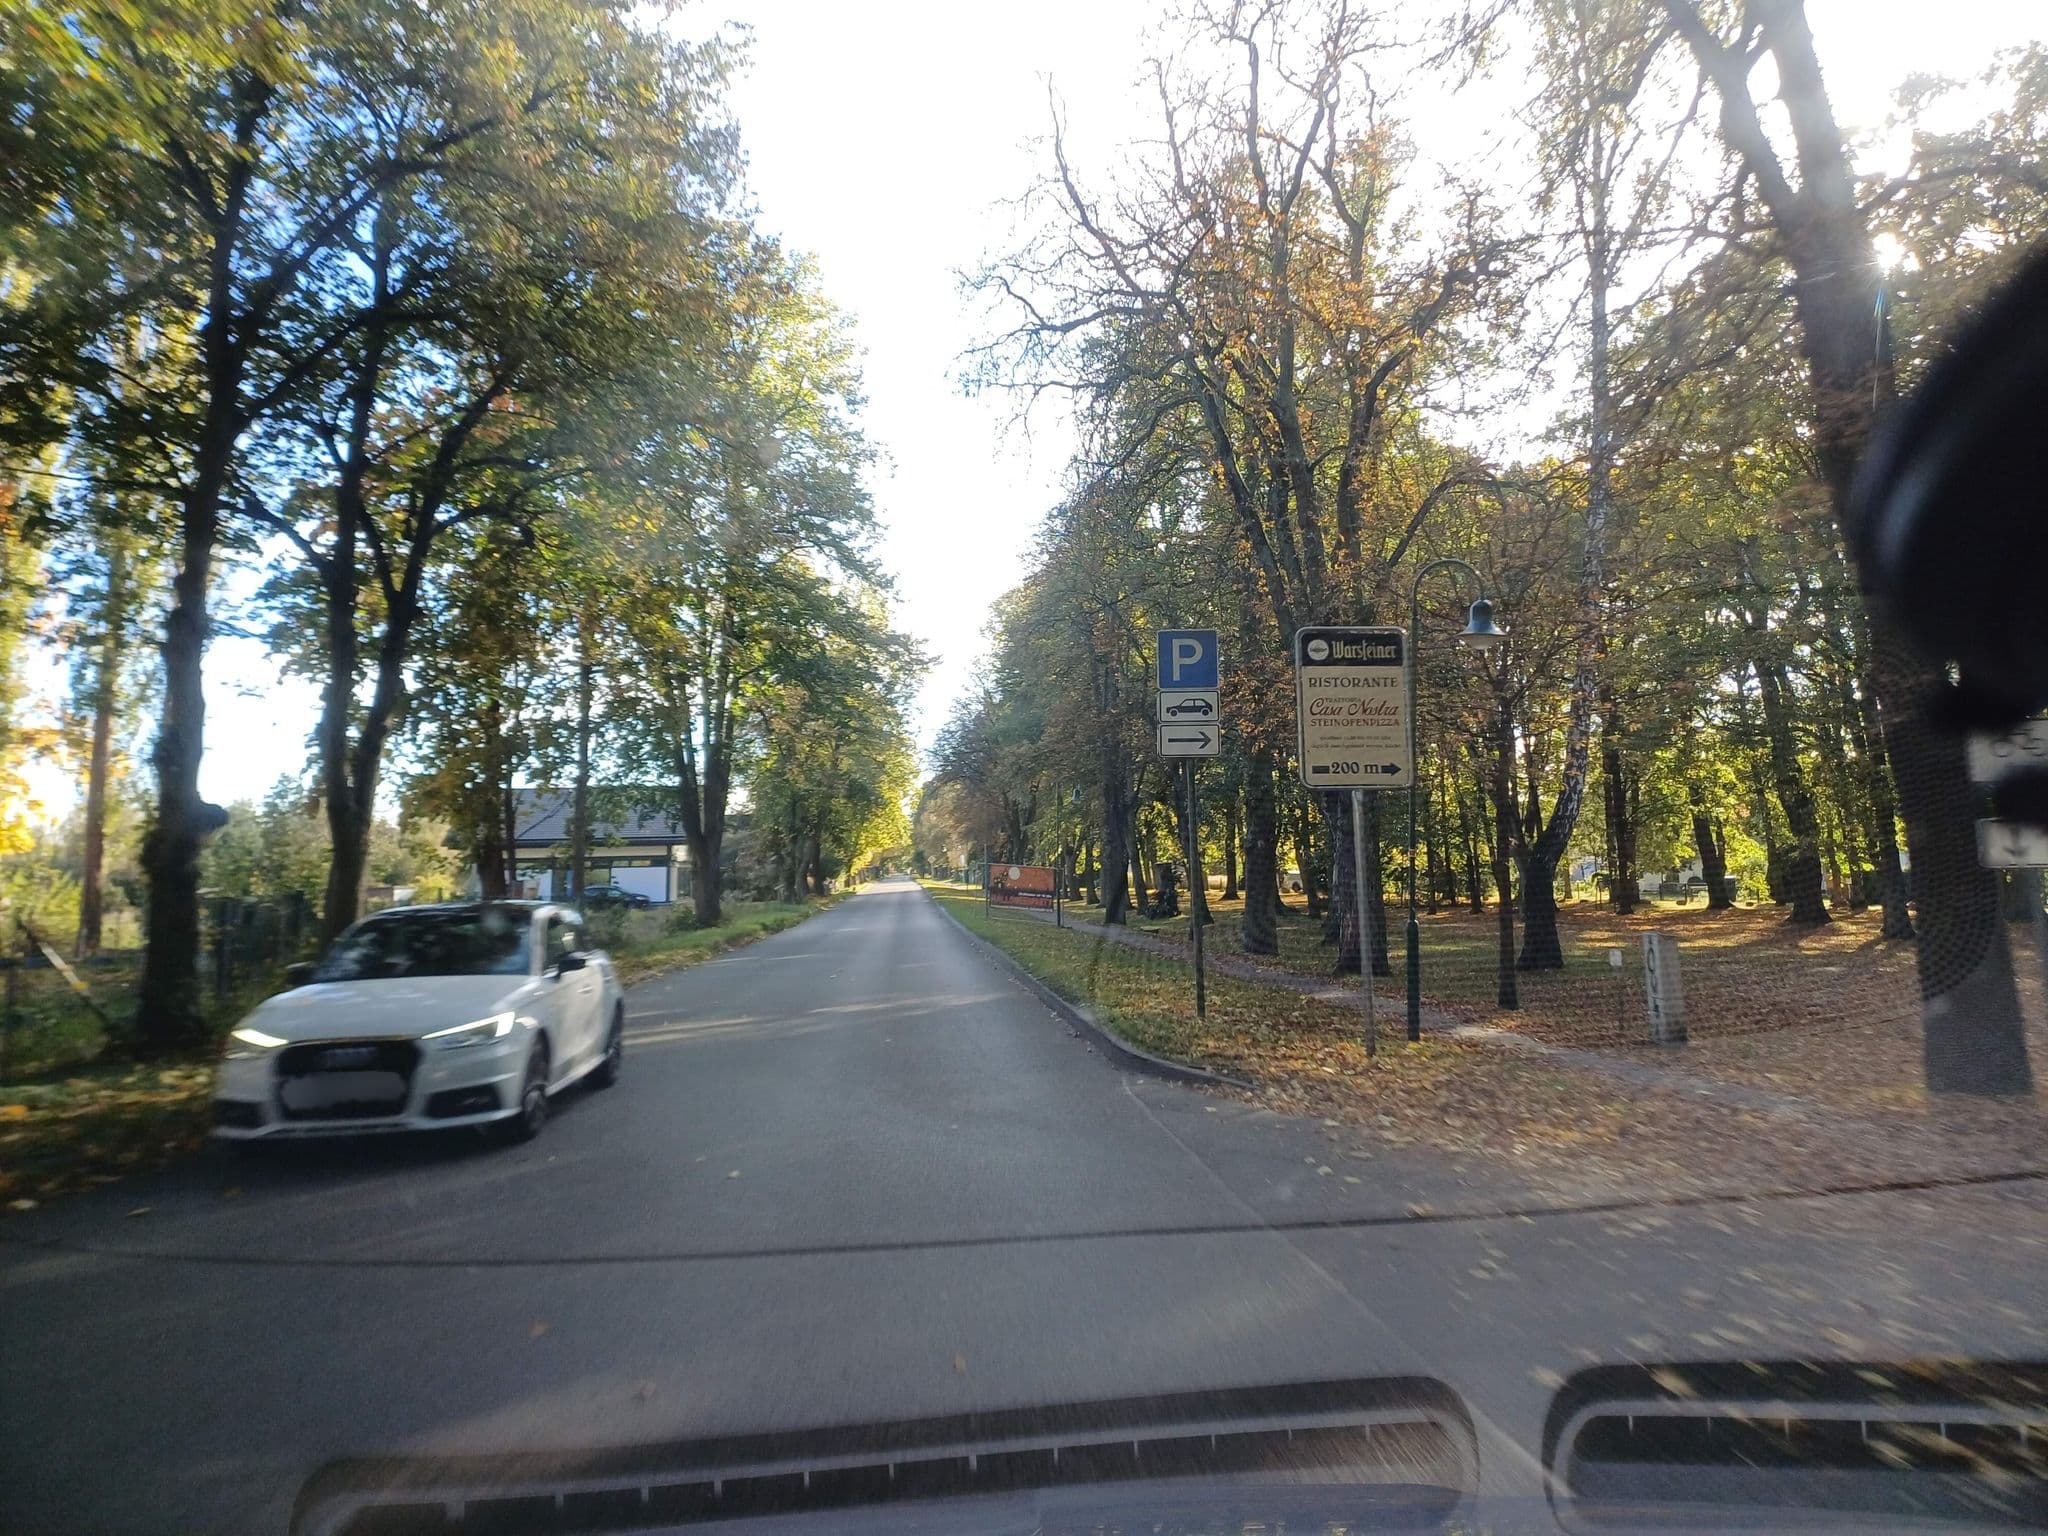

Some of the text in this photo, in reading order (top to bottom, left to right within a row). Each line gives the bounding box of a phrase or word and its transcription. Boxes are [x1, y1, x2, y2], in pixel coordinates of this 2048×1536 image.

[1331, 640, 1397, 660] Warsteiner
[1172, 638, 1203, 681] P
[1308, 677, 1398, 688] RISTORANTE
[1309, 698, 1400, 716] Casa Nostra
[1310, 718, 1400, 727] STEINOFENPIZZA
[1331, 761, 1380, 775] 200 m
